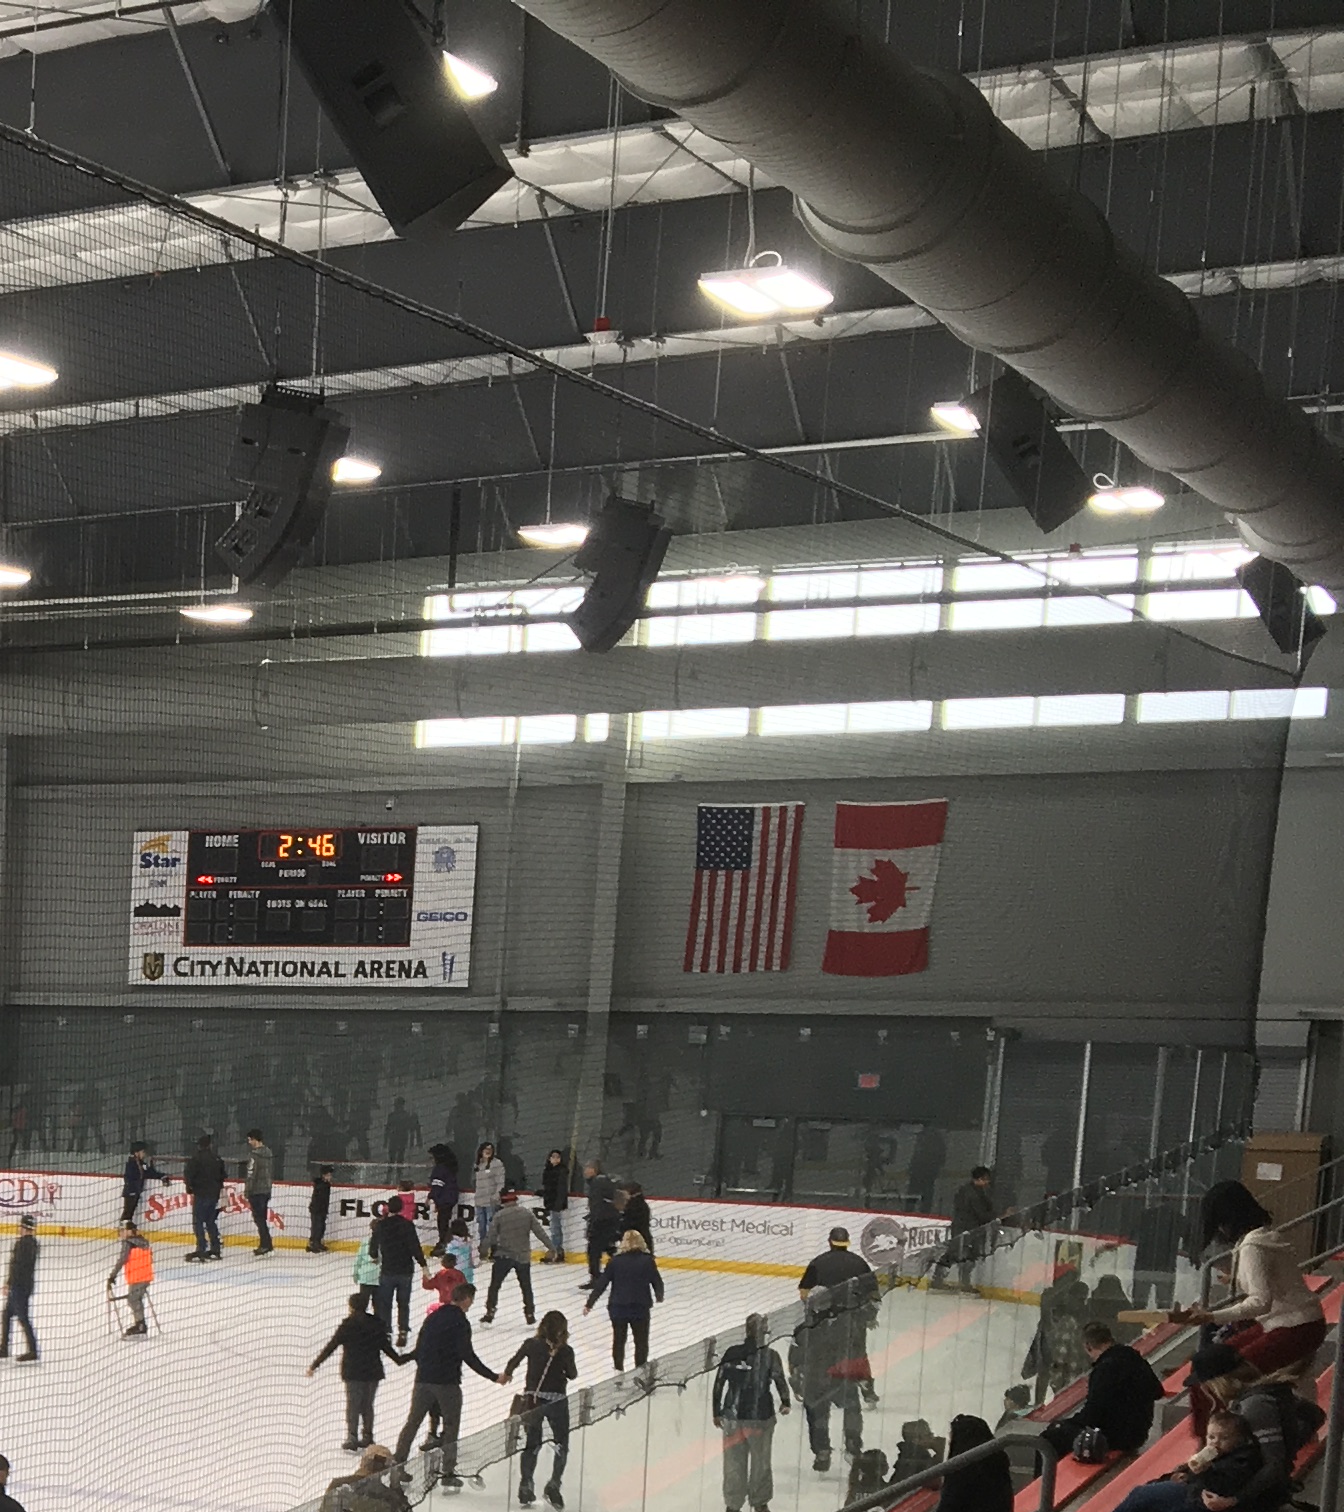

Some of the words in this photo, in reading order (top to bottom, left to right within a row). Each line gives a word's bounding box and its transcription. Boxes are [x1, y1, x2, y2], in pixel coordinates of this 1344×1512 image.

[205, 834, 240, 848] HOME
[278, 834, 335, 858] 2:46
[358, 832, 407, 845] VISITOR
[140, 852, 181, 869] Star
[416, 911, 468, 922] GEICO
[353, 958, 429, 979] ARENA
[649, 1214, 727, 1233] outhwest
[730, 1218, 794, 1237] Medical
